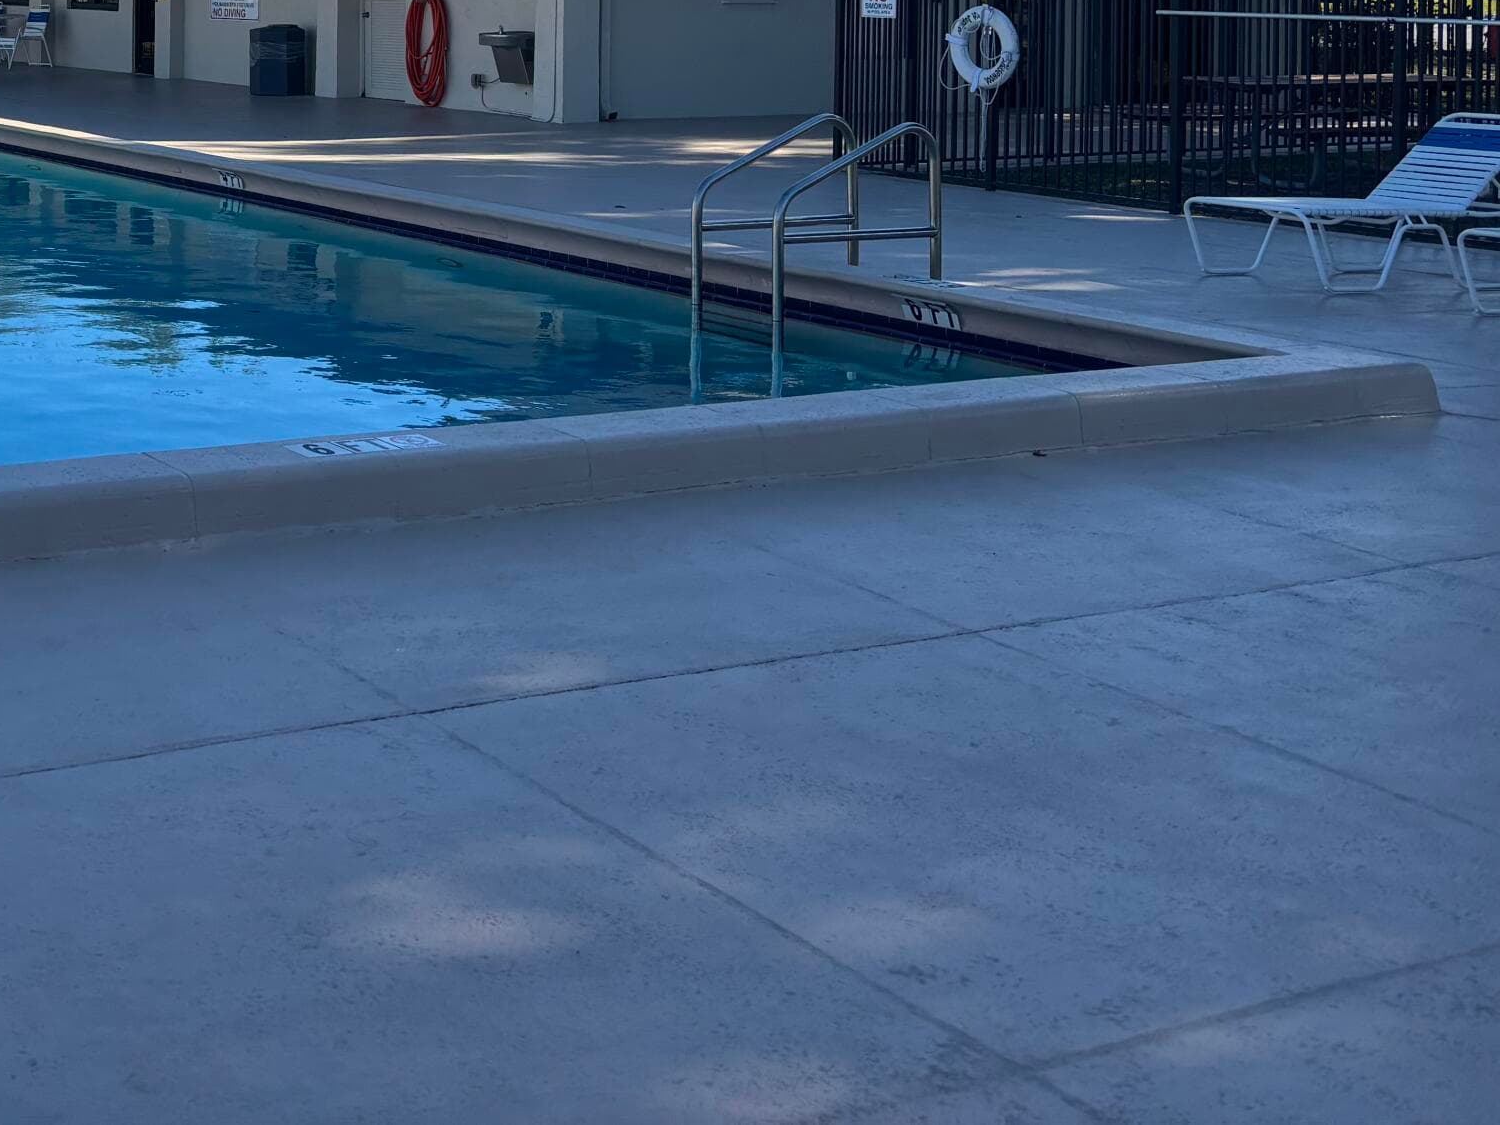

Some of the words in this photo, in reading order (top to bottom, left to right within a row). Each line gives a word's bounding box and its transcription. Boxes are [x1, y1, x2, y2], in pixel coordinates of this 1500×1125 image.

[211, 8, 223, 17] NO
[224, 8, 246, 18] DIVING
[302, 443, 336, 455] 6
[337, 437, 390, 452] FT
